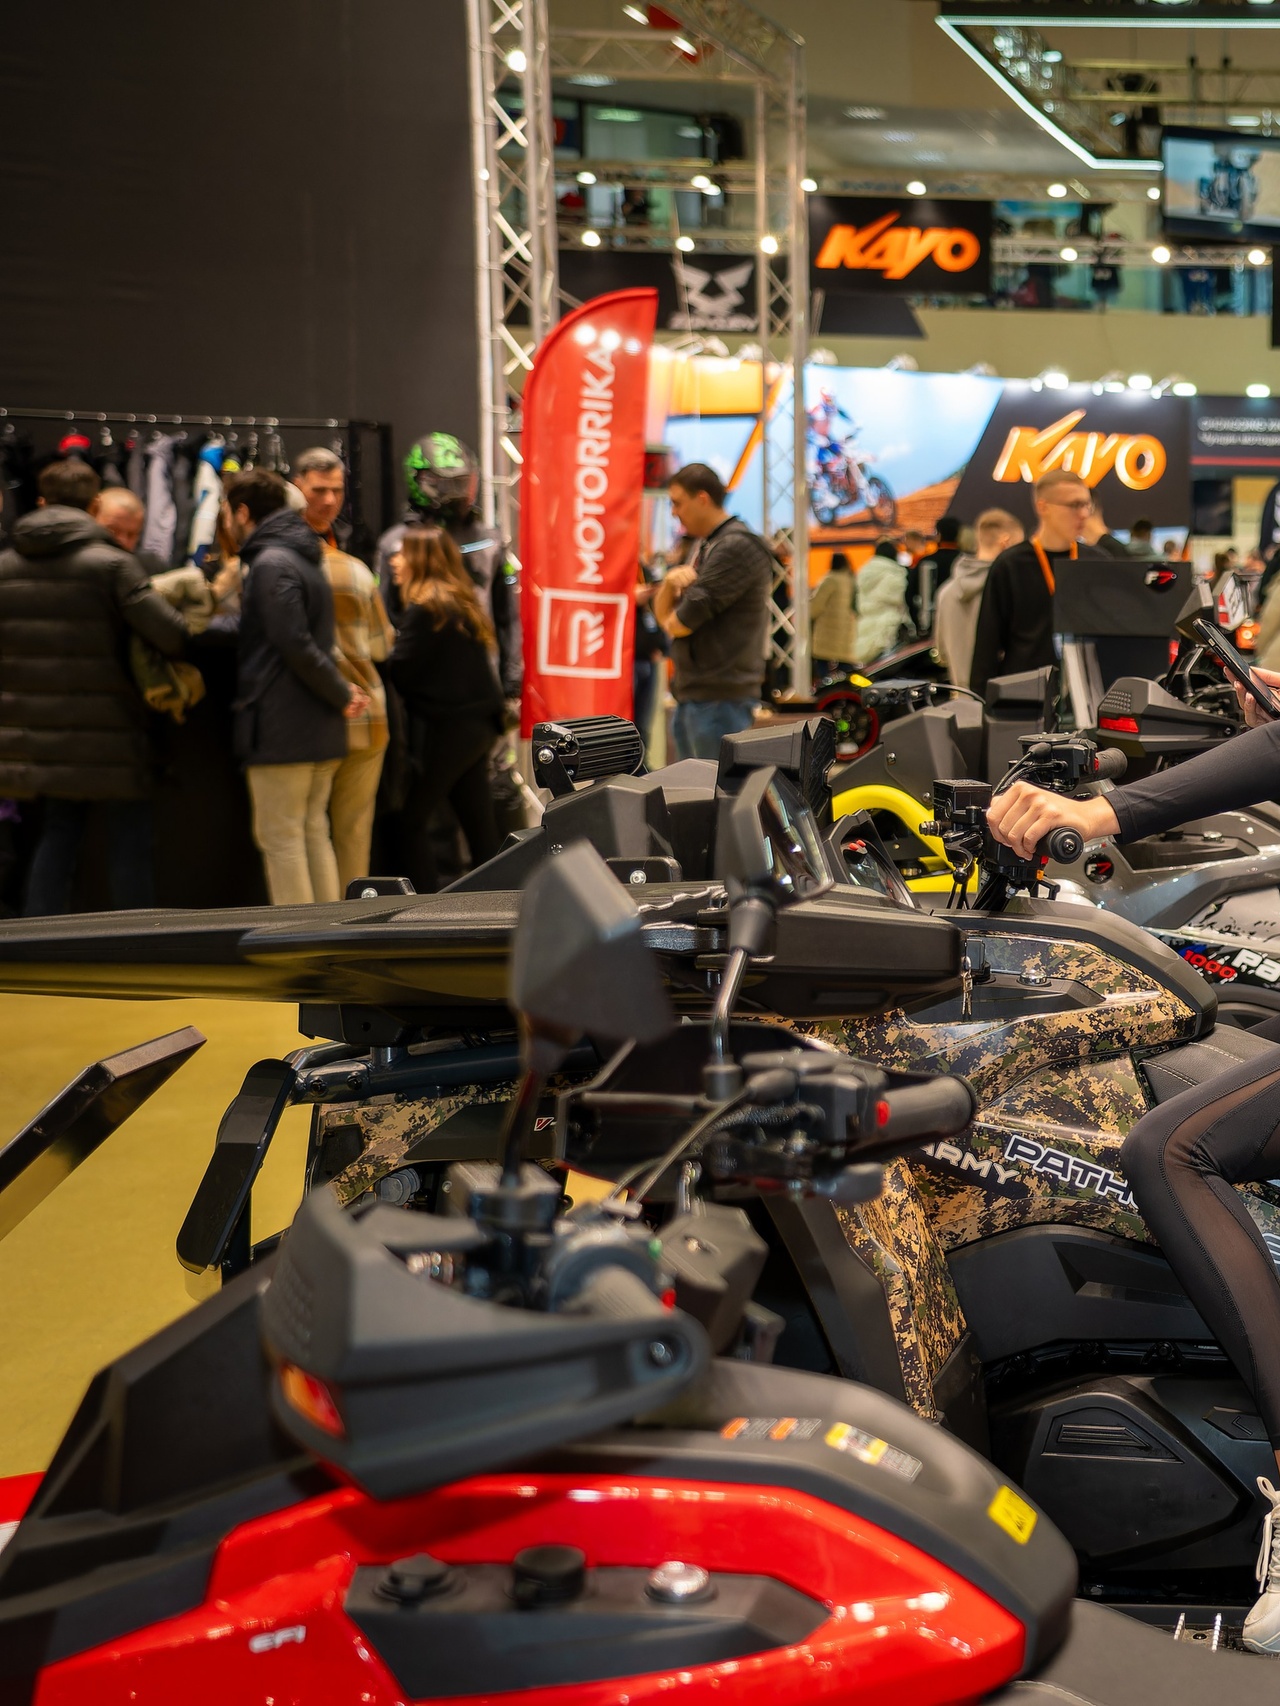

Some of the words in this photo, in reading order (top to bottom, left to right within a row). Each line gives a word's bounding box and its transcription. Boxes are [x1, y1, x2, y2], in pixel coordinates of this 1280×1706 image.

[814, 210, 981, 280] KAYO
[574, 347, 615, 584] MOTORRIKA
[1183, 949, 1237, 979] 1000
